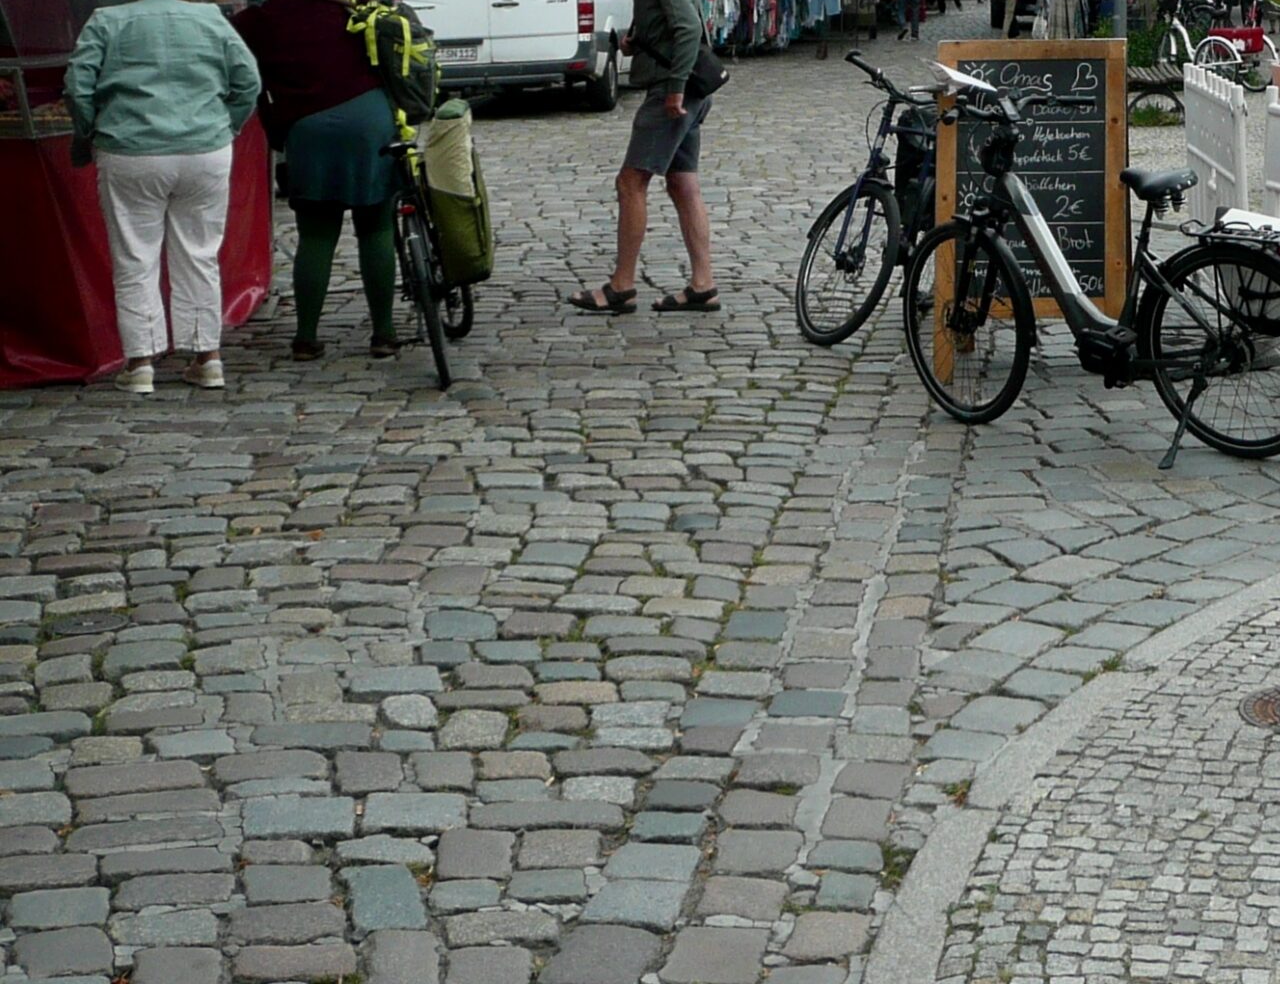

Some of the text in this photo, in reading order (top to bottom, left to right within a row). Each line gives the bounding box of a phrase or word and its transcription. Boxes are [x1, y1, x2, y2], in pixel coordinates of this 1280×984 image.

[1000, 62, 1053, 91] Omas
[1067, 143, 1094, 161] 5€
[1052, 194, 1085, 219] 2€
[1056, 226, 1095, 252] Brot
